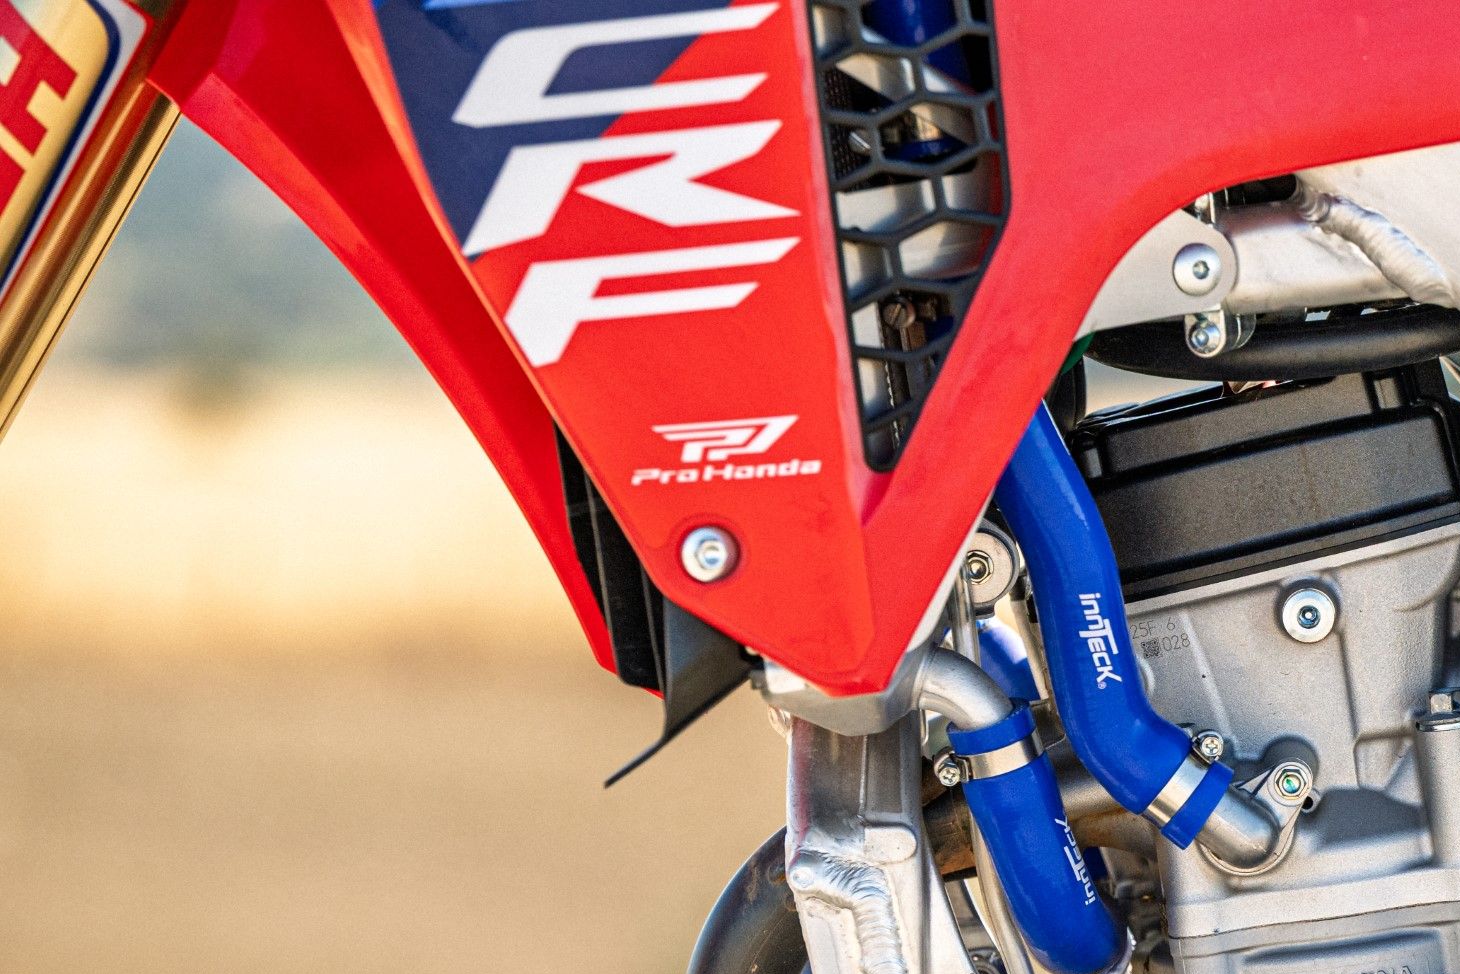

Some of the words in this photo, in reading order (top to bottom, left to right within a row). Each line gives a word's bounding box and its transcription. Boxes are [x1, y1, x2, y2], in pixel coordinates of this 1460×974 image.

[452, 2, 802, 368] CRF
[631, 467, 698, 486] Pro
[702, 458, 822, 481] Honda
[1162, 632, 1191, 651] 028
